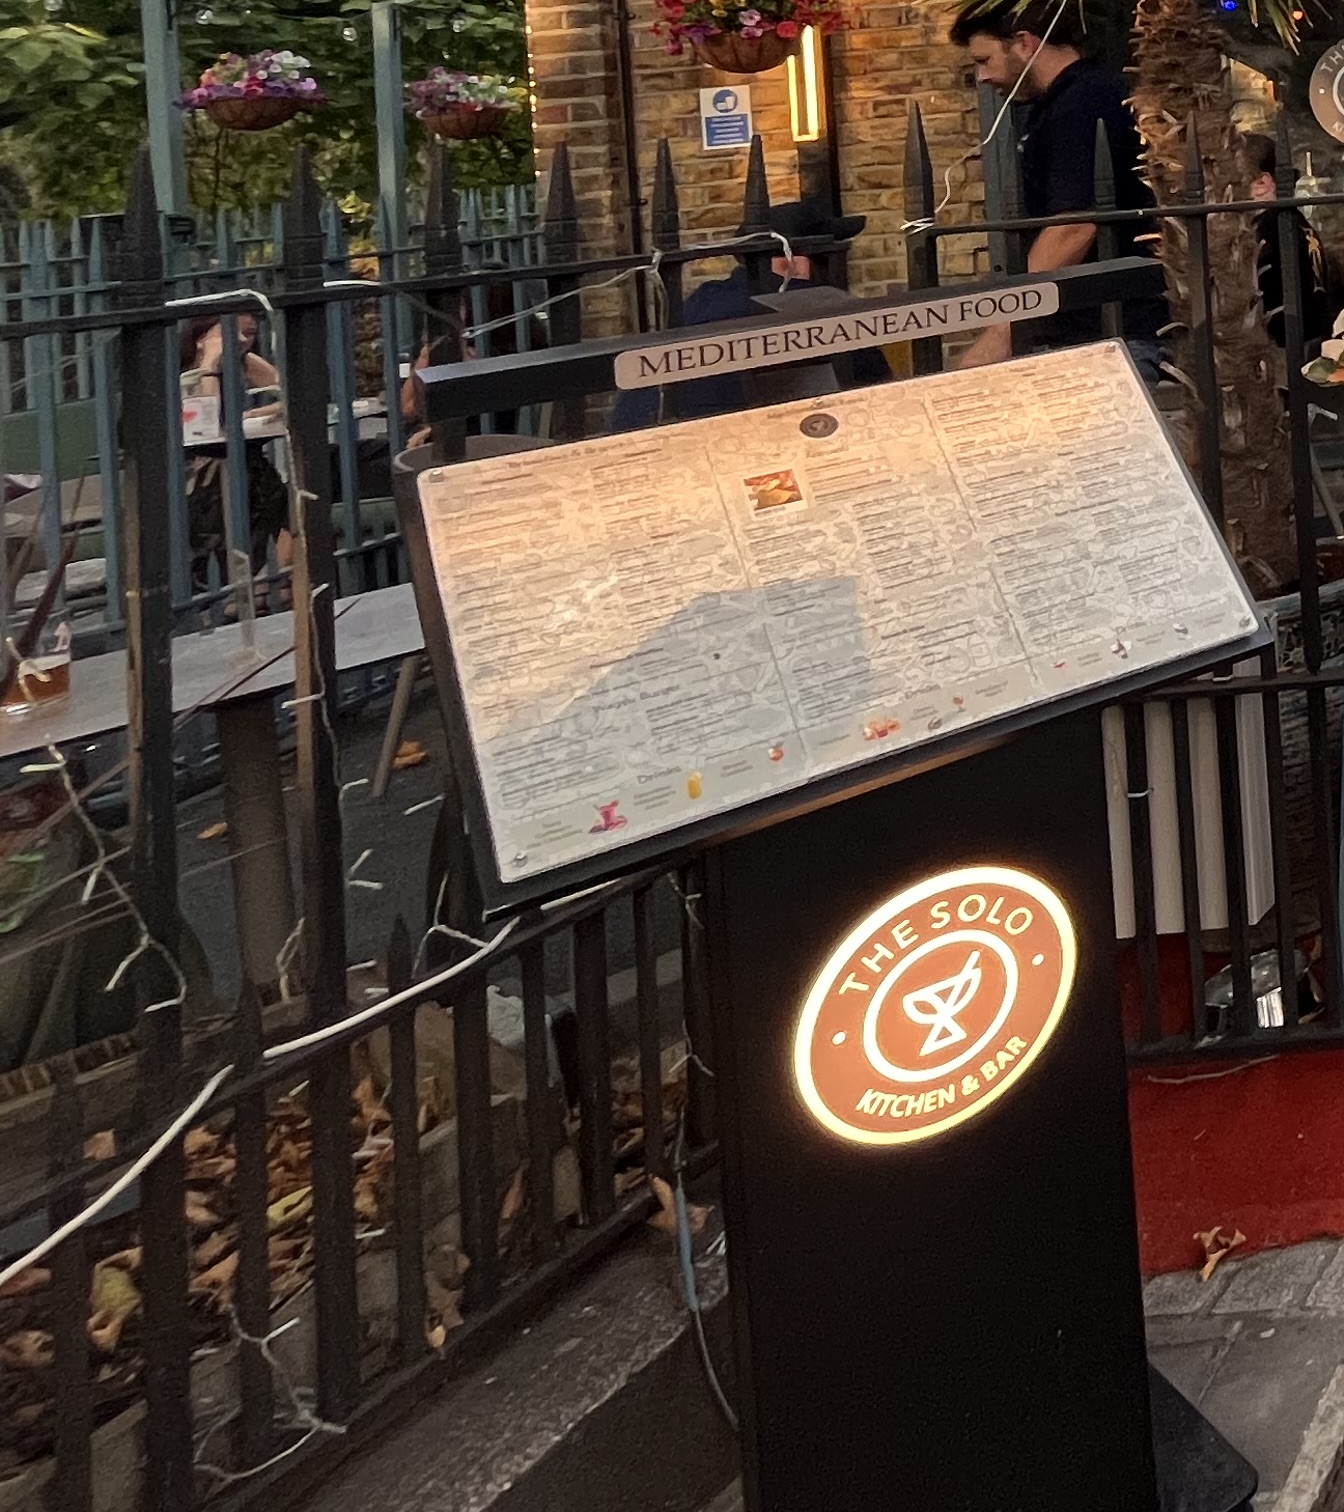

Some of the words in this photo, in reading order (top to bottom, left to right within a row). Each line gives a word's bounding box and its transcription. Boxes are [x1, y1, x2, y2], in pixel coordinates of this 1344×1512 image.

[638, 303, 950, 379] MEDITERRANEAN
[959, 289, 1042, 323] FOOD
[838, 918, 920, 995] THE
[930, 893, 1033, 936] SOLO
[855, 1083, 955, 1118] KITCHEN
[960, 1074, 981, 1096] &
[979, 1035, 1027, 1082] BAR
